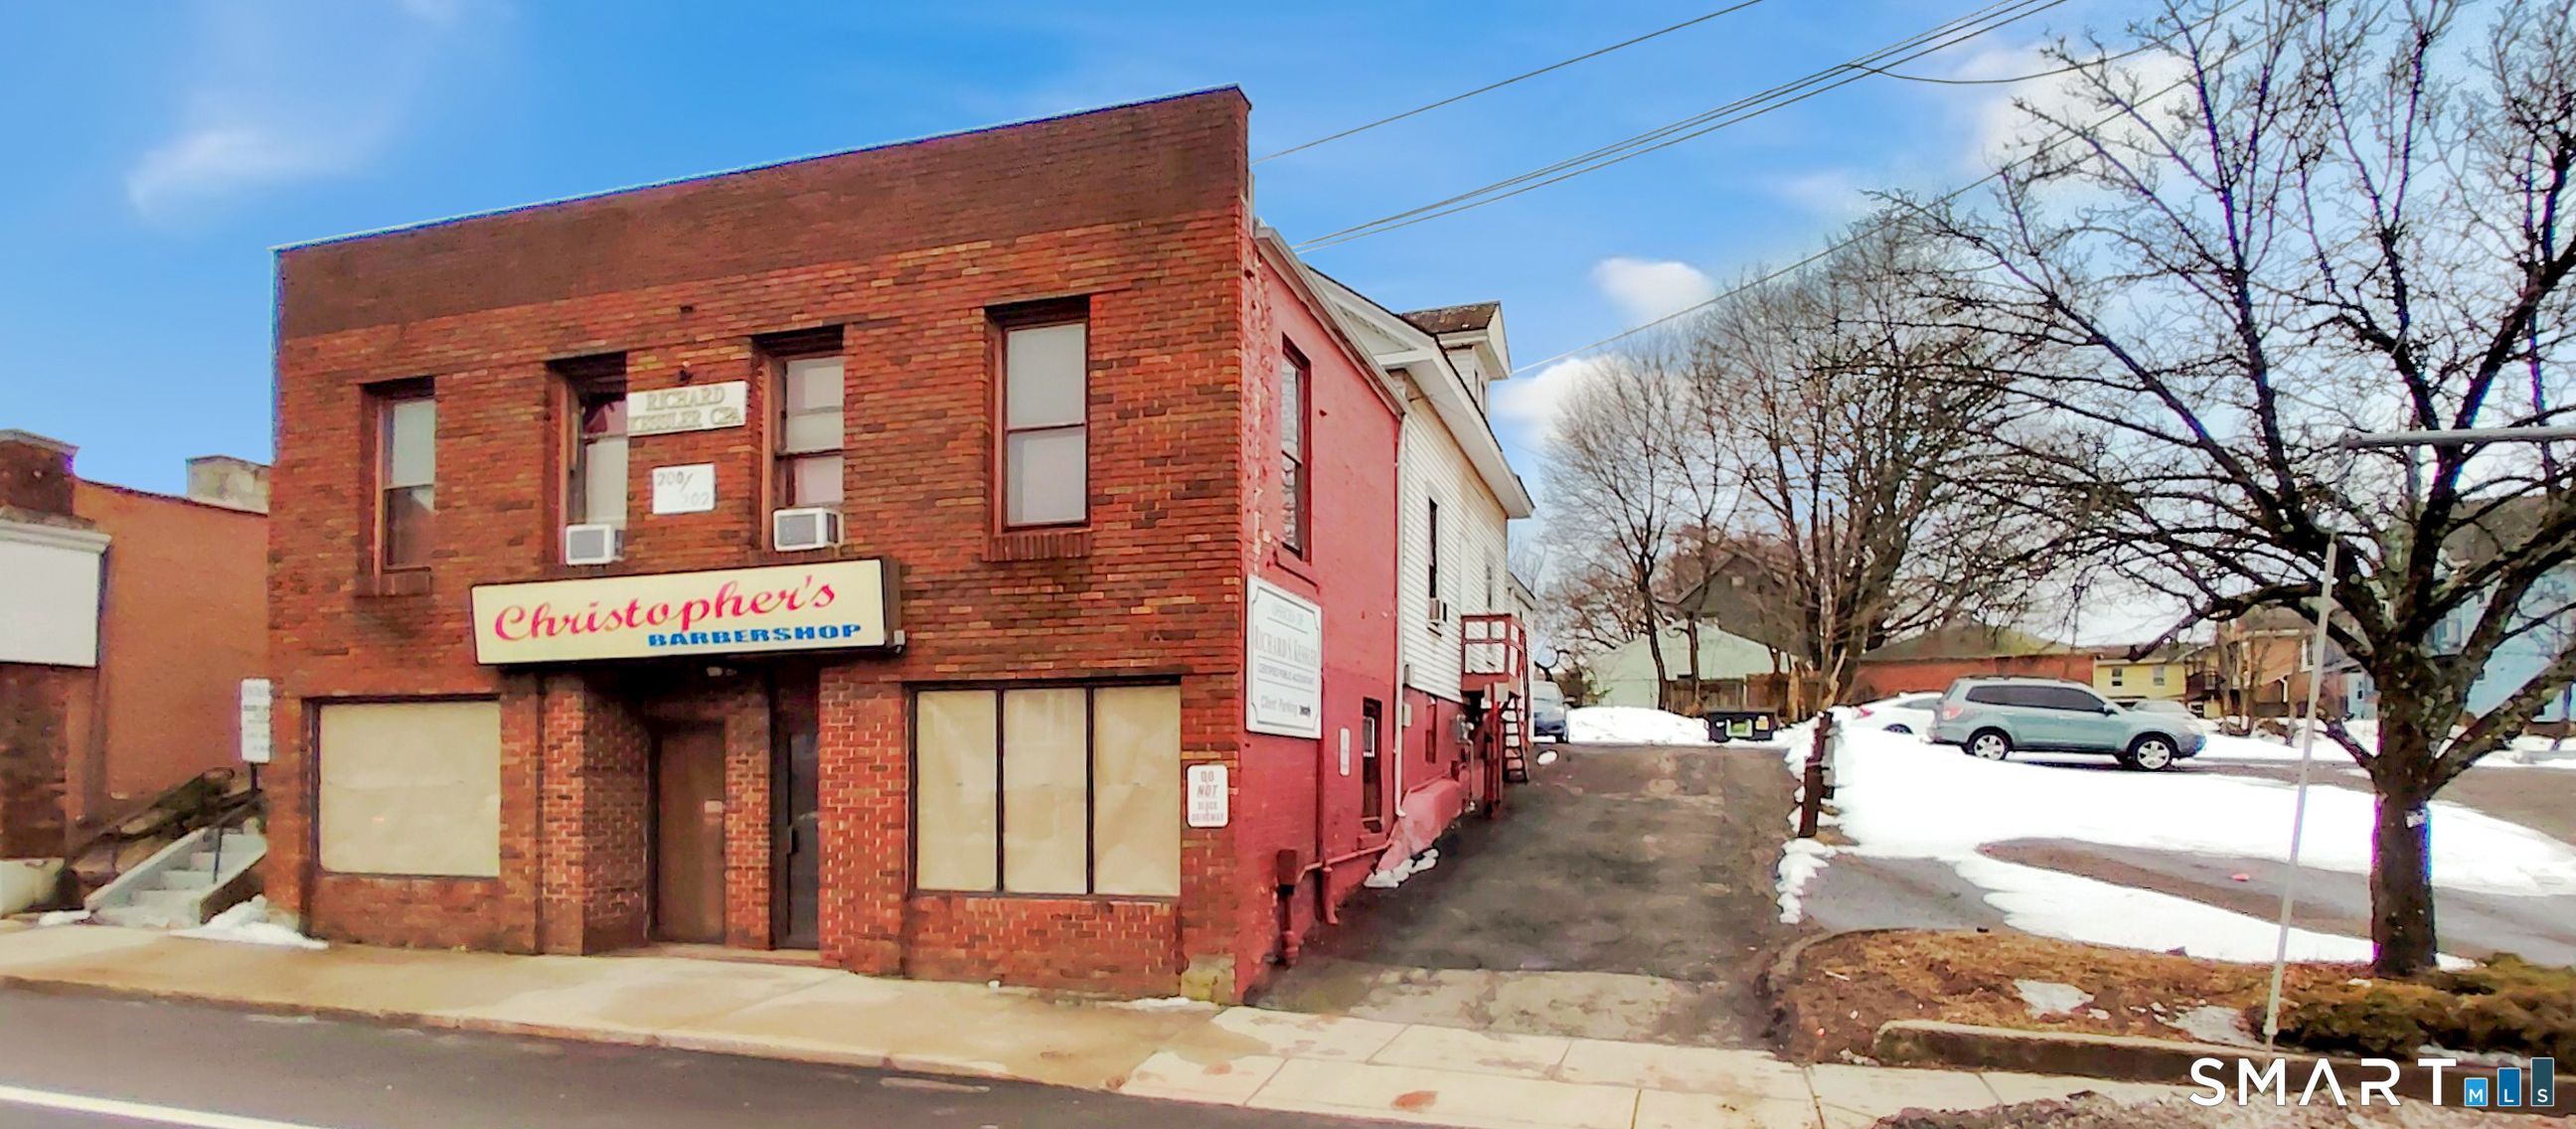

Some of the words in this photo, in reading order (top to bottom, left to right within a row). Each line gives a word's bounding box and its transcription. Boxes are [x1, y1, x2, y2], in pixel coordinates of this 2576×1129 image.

[646, 385, 725, 411] RICHARD
[494, 574, 836, 643] Christopher's
[648, 624, 863, 648] BARBERSHOP
[1201, 770, 1214, 783] DO
[1197, 784, 1219, 798] NOT
